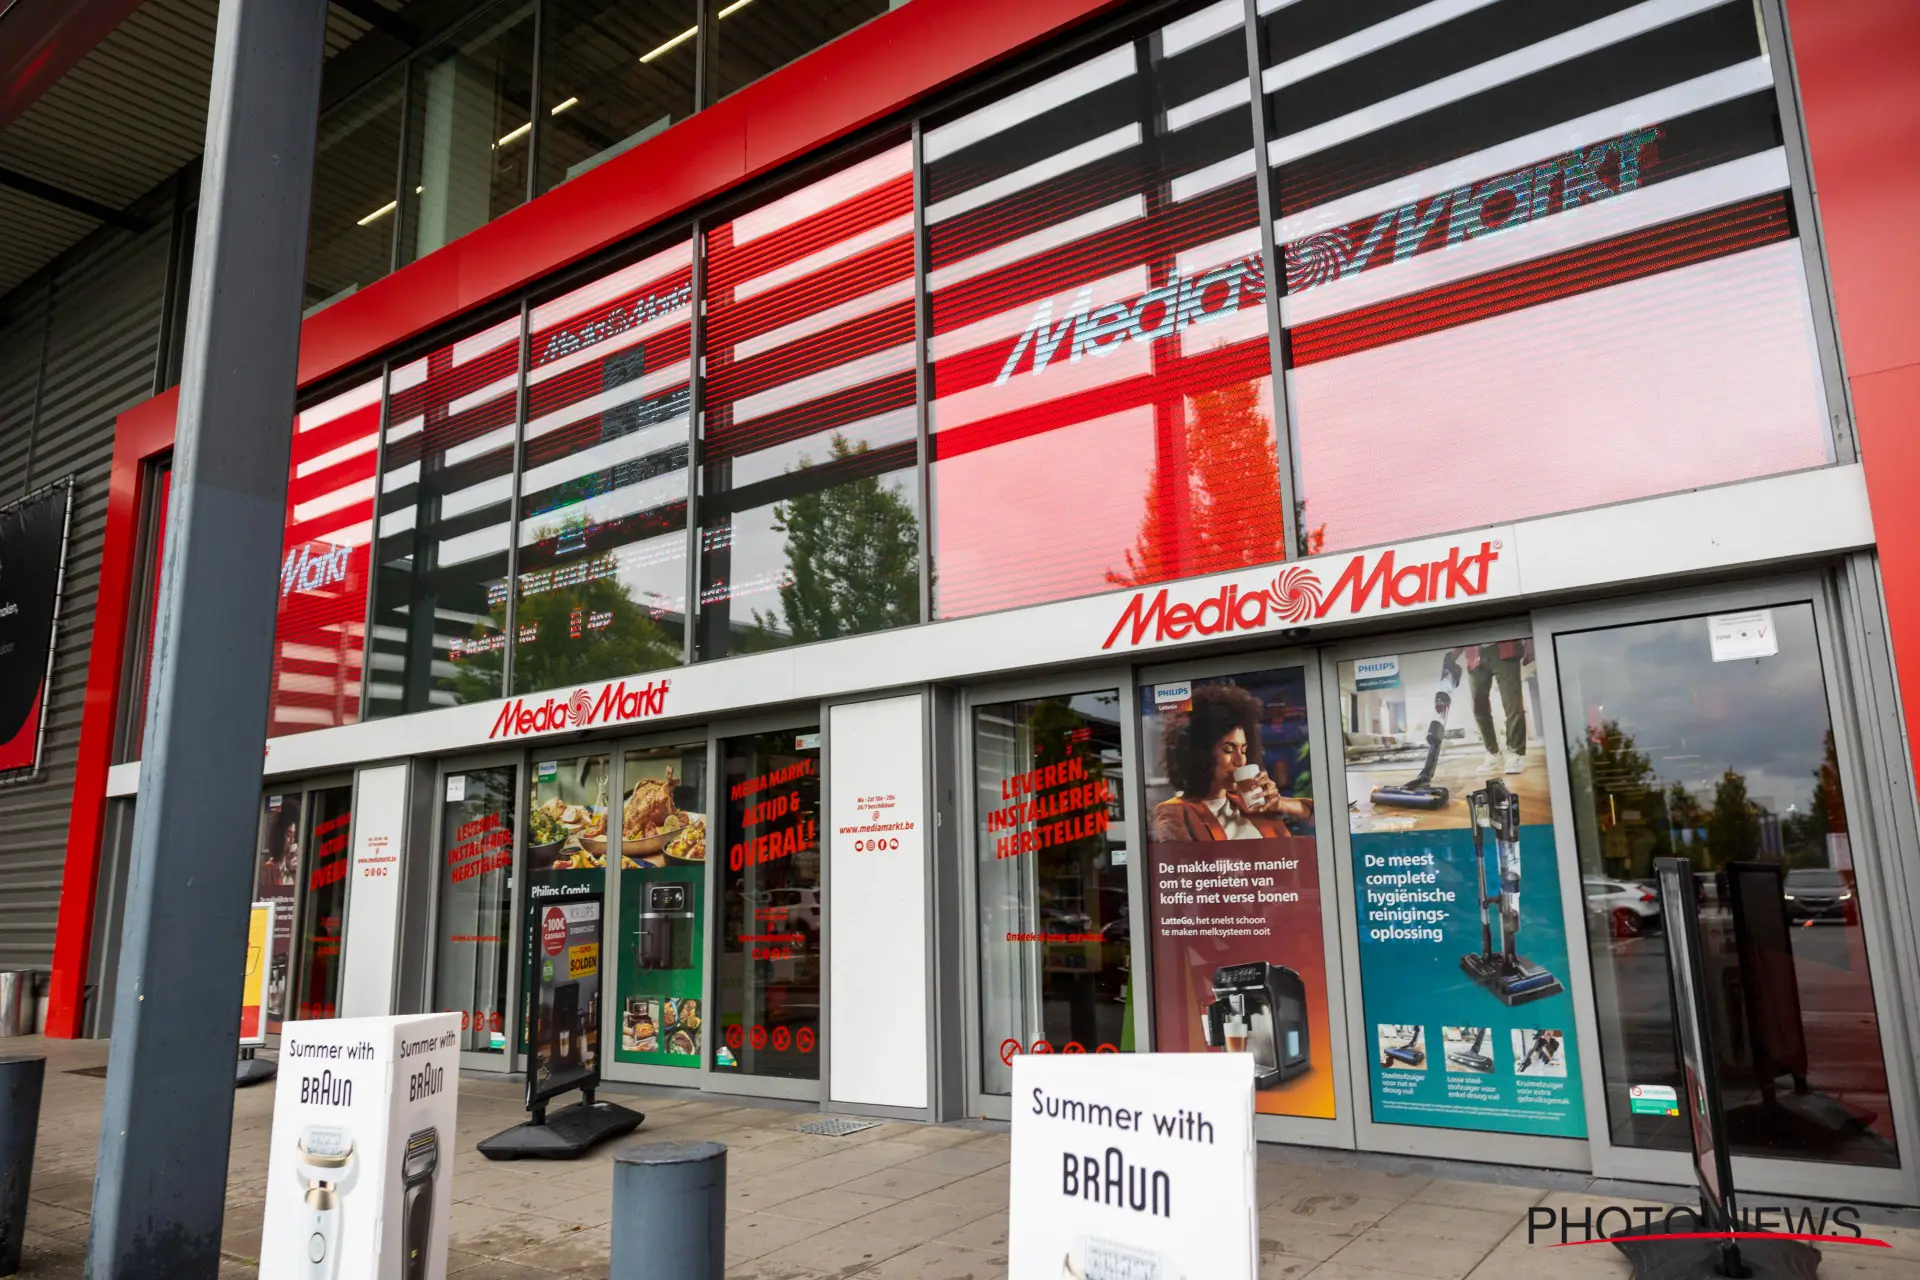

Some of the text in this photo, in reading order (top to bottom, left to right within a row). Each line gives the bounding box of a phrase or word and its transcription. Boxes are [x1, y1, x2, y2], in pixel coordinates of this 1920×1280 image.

[993, 124, 1661, 387] Media Markt
[280, 544, 352, 597] Markt
[1103, 542, 1499, 650] Media Markt
[1358, 661, 1395, 673] PHILIPS
[1157, 687, 1188, 698] PHILIPS
[489, 680, 669, 739] Media Markt
[1158, 703, 1178, 711] LatteGo
[731, 758, 815, 802] MEDIA MARKT,
[1002, 756, 1089, 801] LEVEREN,
[742, 790, 801, 829] ALTIJD &
[988, 779, 1115, 833] INSTALLEREN,
[839, 821, 915, 834] www.mediamarkt.be
[996, 809, 1116, 860] HERSTELLEN.
[730, 819, 815, 872] OVERAL!
[1158, 858, 1299, 875] De makkelijkste manier
[1365, 853, 1434, 867] De meest
[310, 858, 348, 891] OVERA
[1159, 875, 1274, 891] om te genieten van
[1160, 891, 1299, 904] koffie met verse bonen
[1367, 888, 1456, 906] hygiënische
[570, 906, 595, 919] KRUPS
[1161, 915, 1266, 926] LatteGo, het snelst schoon
[1369, 907, 1450, 925] reinigings-
[1006, 932, 1036, 942] Ontdek
[1161, 927, 1271, 938] te maken melksysteem ooit
[1370, 925, 1444, 943] oplossing
[570, 956, 596, 972] SOLDEN
[289, 1039, 374, 1060] Summer with
[400, 1031, 456, 1059] Summer with
[300, 1069, 352, 1107] BRAUN
[409, 1062, 443, 1102] BRAUN
[1383, 1086, 1402, 1095] droog
[1467, 1092, 1487, 1101] droog
[1032, 1087, 1214, 1144] Summer with
[1063, 1147, 1170, 1218] BRAUN
